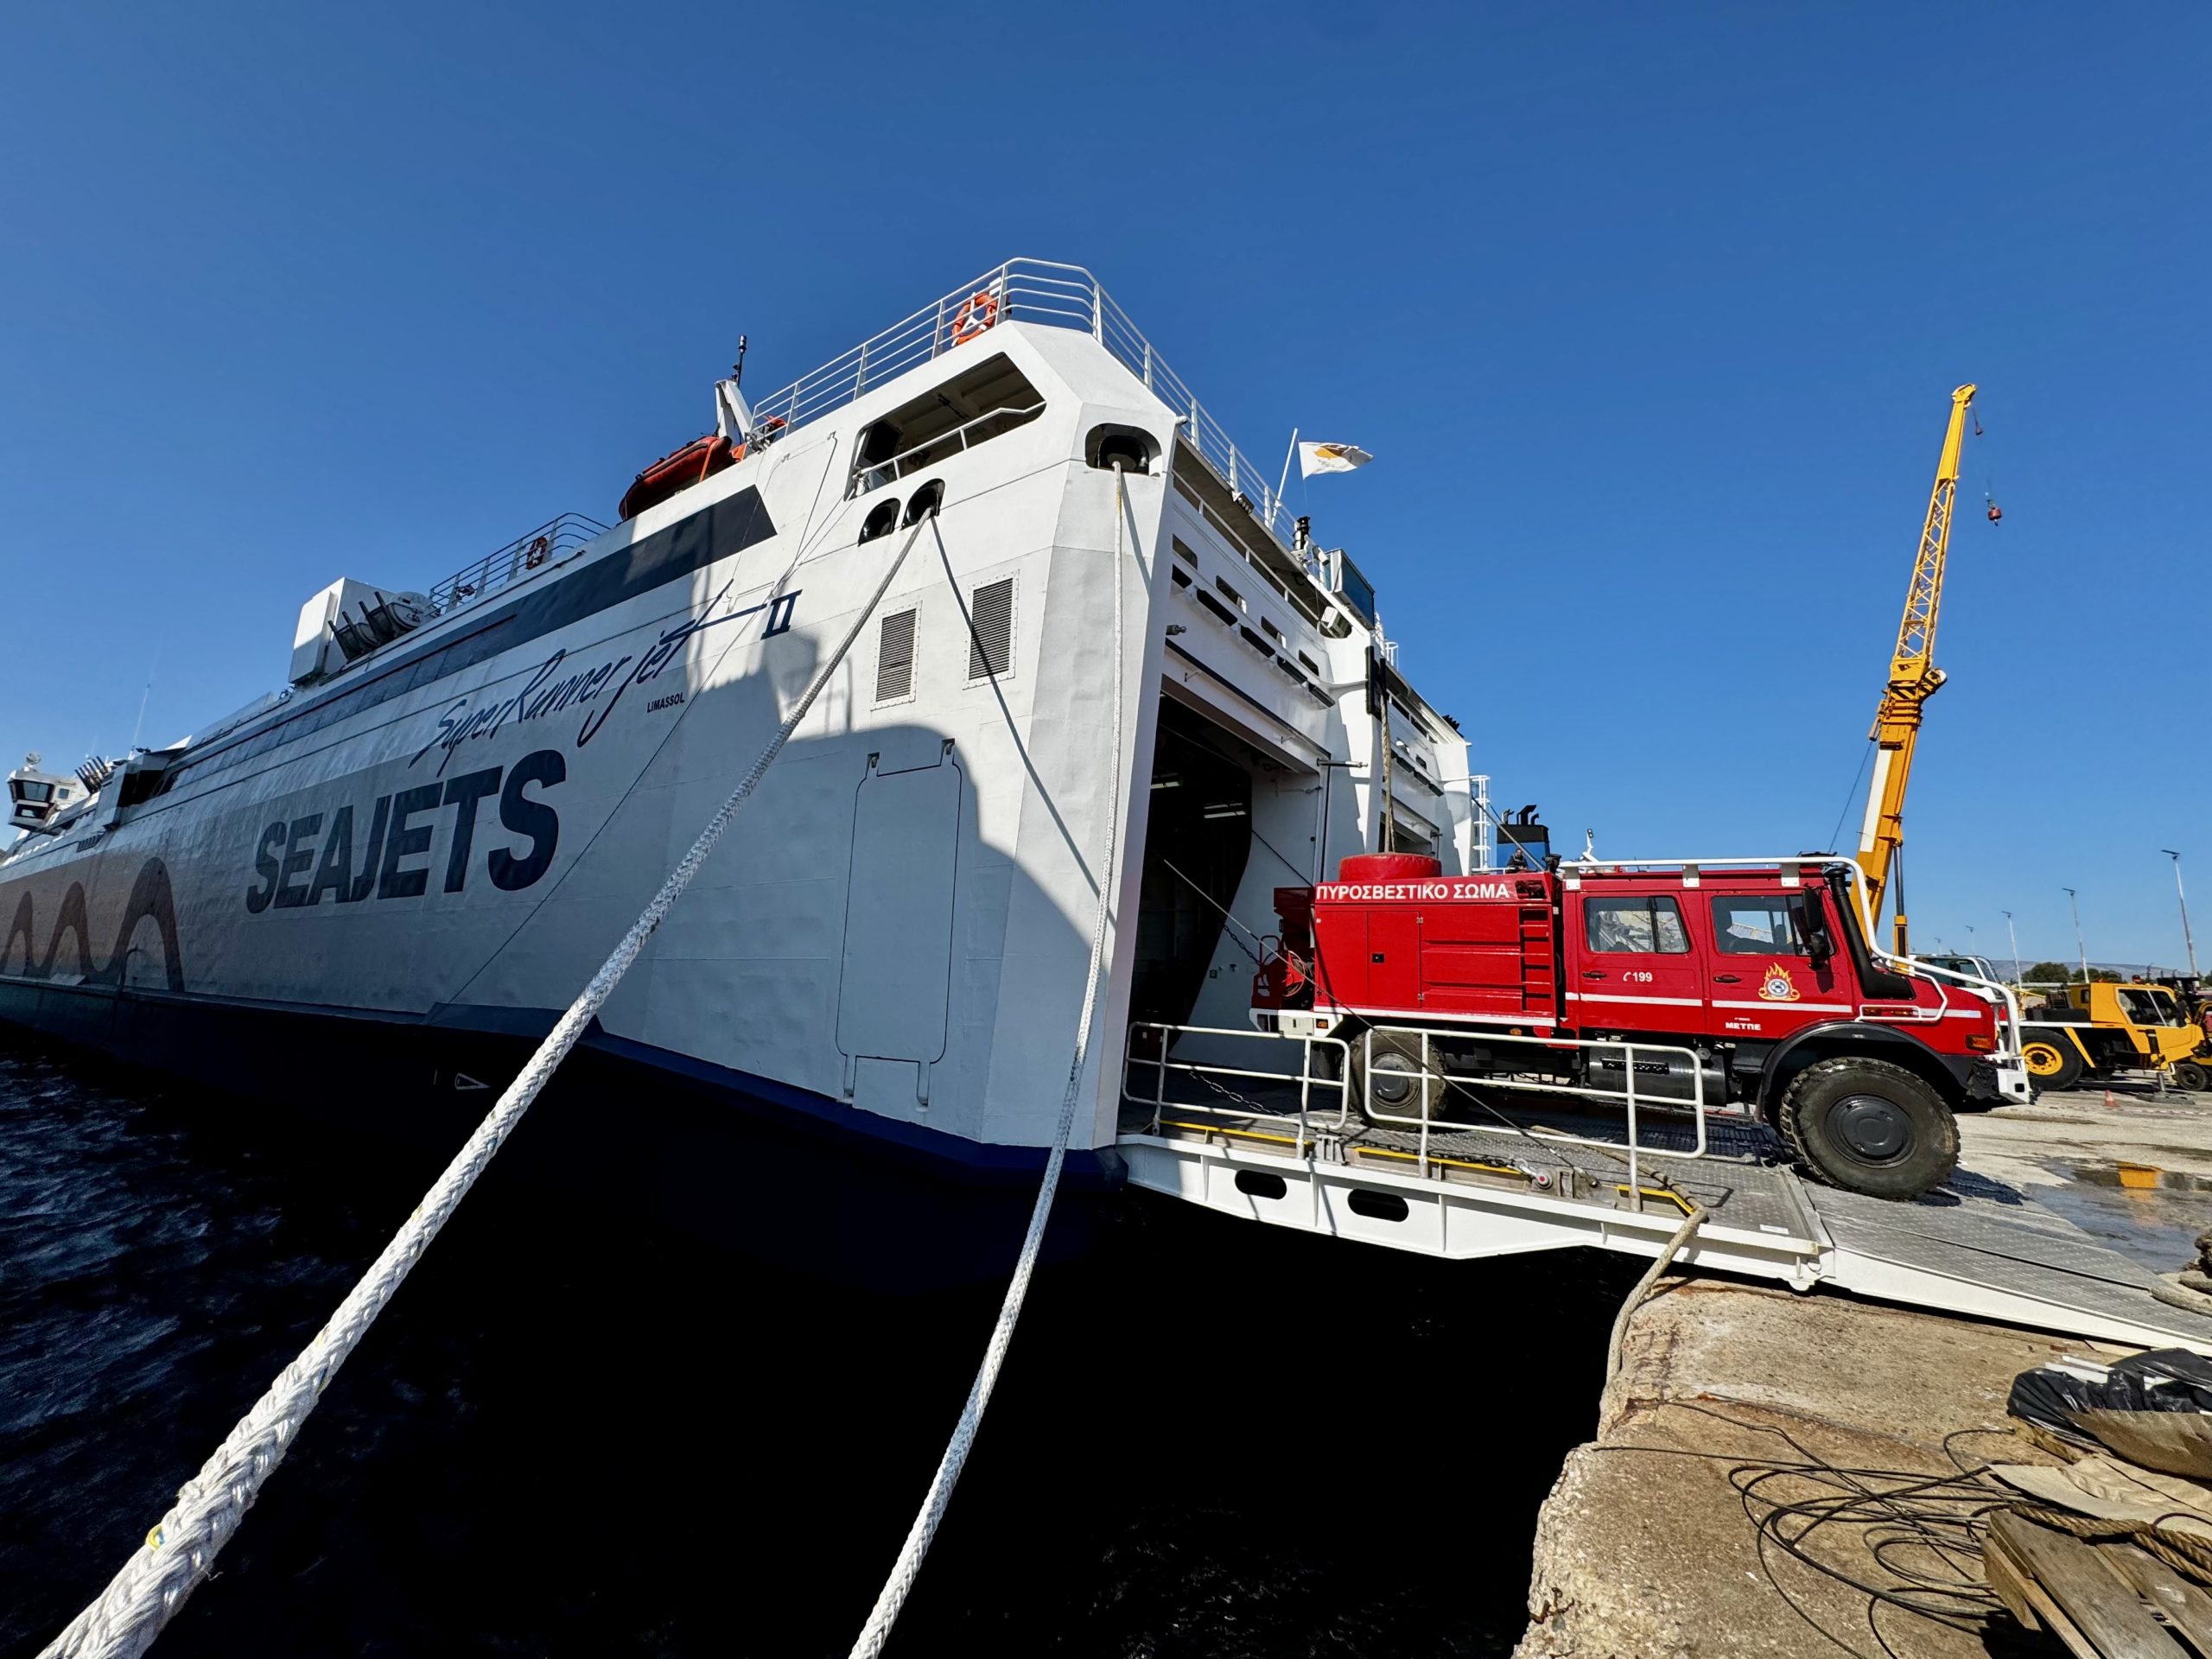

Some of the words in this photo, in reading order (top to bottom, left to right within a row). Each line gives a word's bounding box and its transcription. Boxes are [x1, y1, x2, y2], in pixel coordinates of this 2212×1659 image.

[646, 691, 685, 714] LIMASSOL
[245, 749, 567, 914] SEAJETS
[1316, 884, 1448, 899] ΠΥΡΟΣΒΕΣΤΙΚΟ
[1452, 883, 1510, 899] ΣΩΜΑ
[1632, 971, 1653, 982] 199
